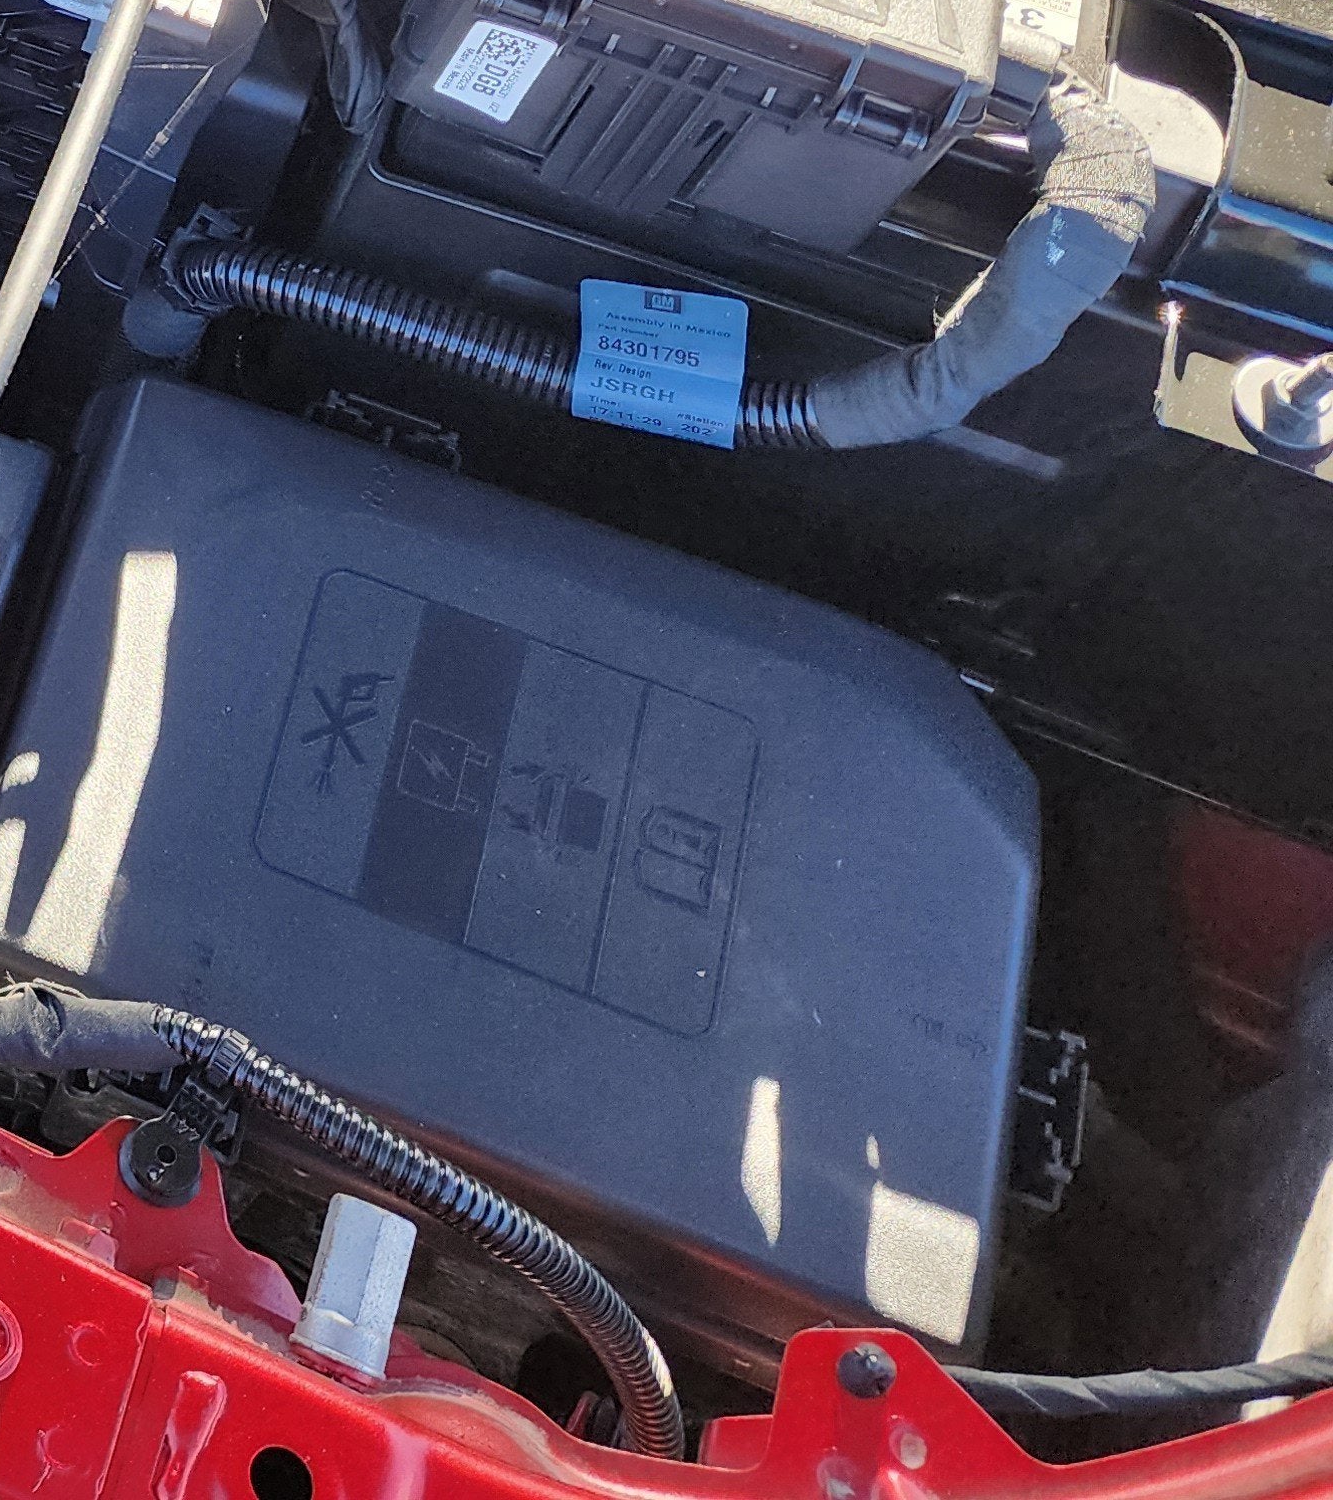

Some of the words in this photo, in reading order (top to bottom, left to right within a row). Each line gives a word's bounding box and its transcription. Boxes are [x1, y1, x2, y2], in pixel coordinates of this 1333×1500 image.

[472, 63, 509, 97] DGB
[597, 322, 618, 333] Part
[621, 327, 660, 338] Number
[606, 311, 665, 330] Assembly
[669, 322, 682, 331] in
[686, 324, 731, 338] Mexico
[598, 335, 701, 368] 84301795
[594, 358, 615, 372] Rev.
[619, 363, 652, 379] Design
[591, 376, 675, 404] JSRGH
